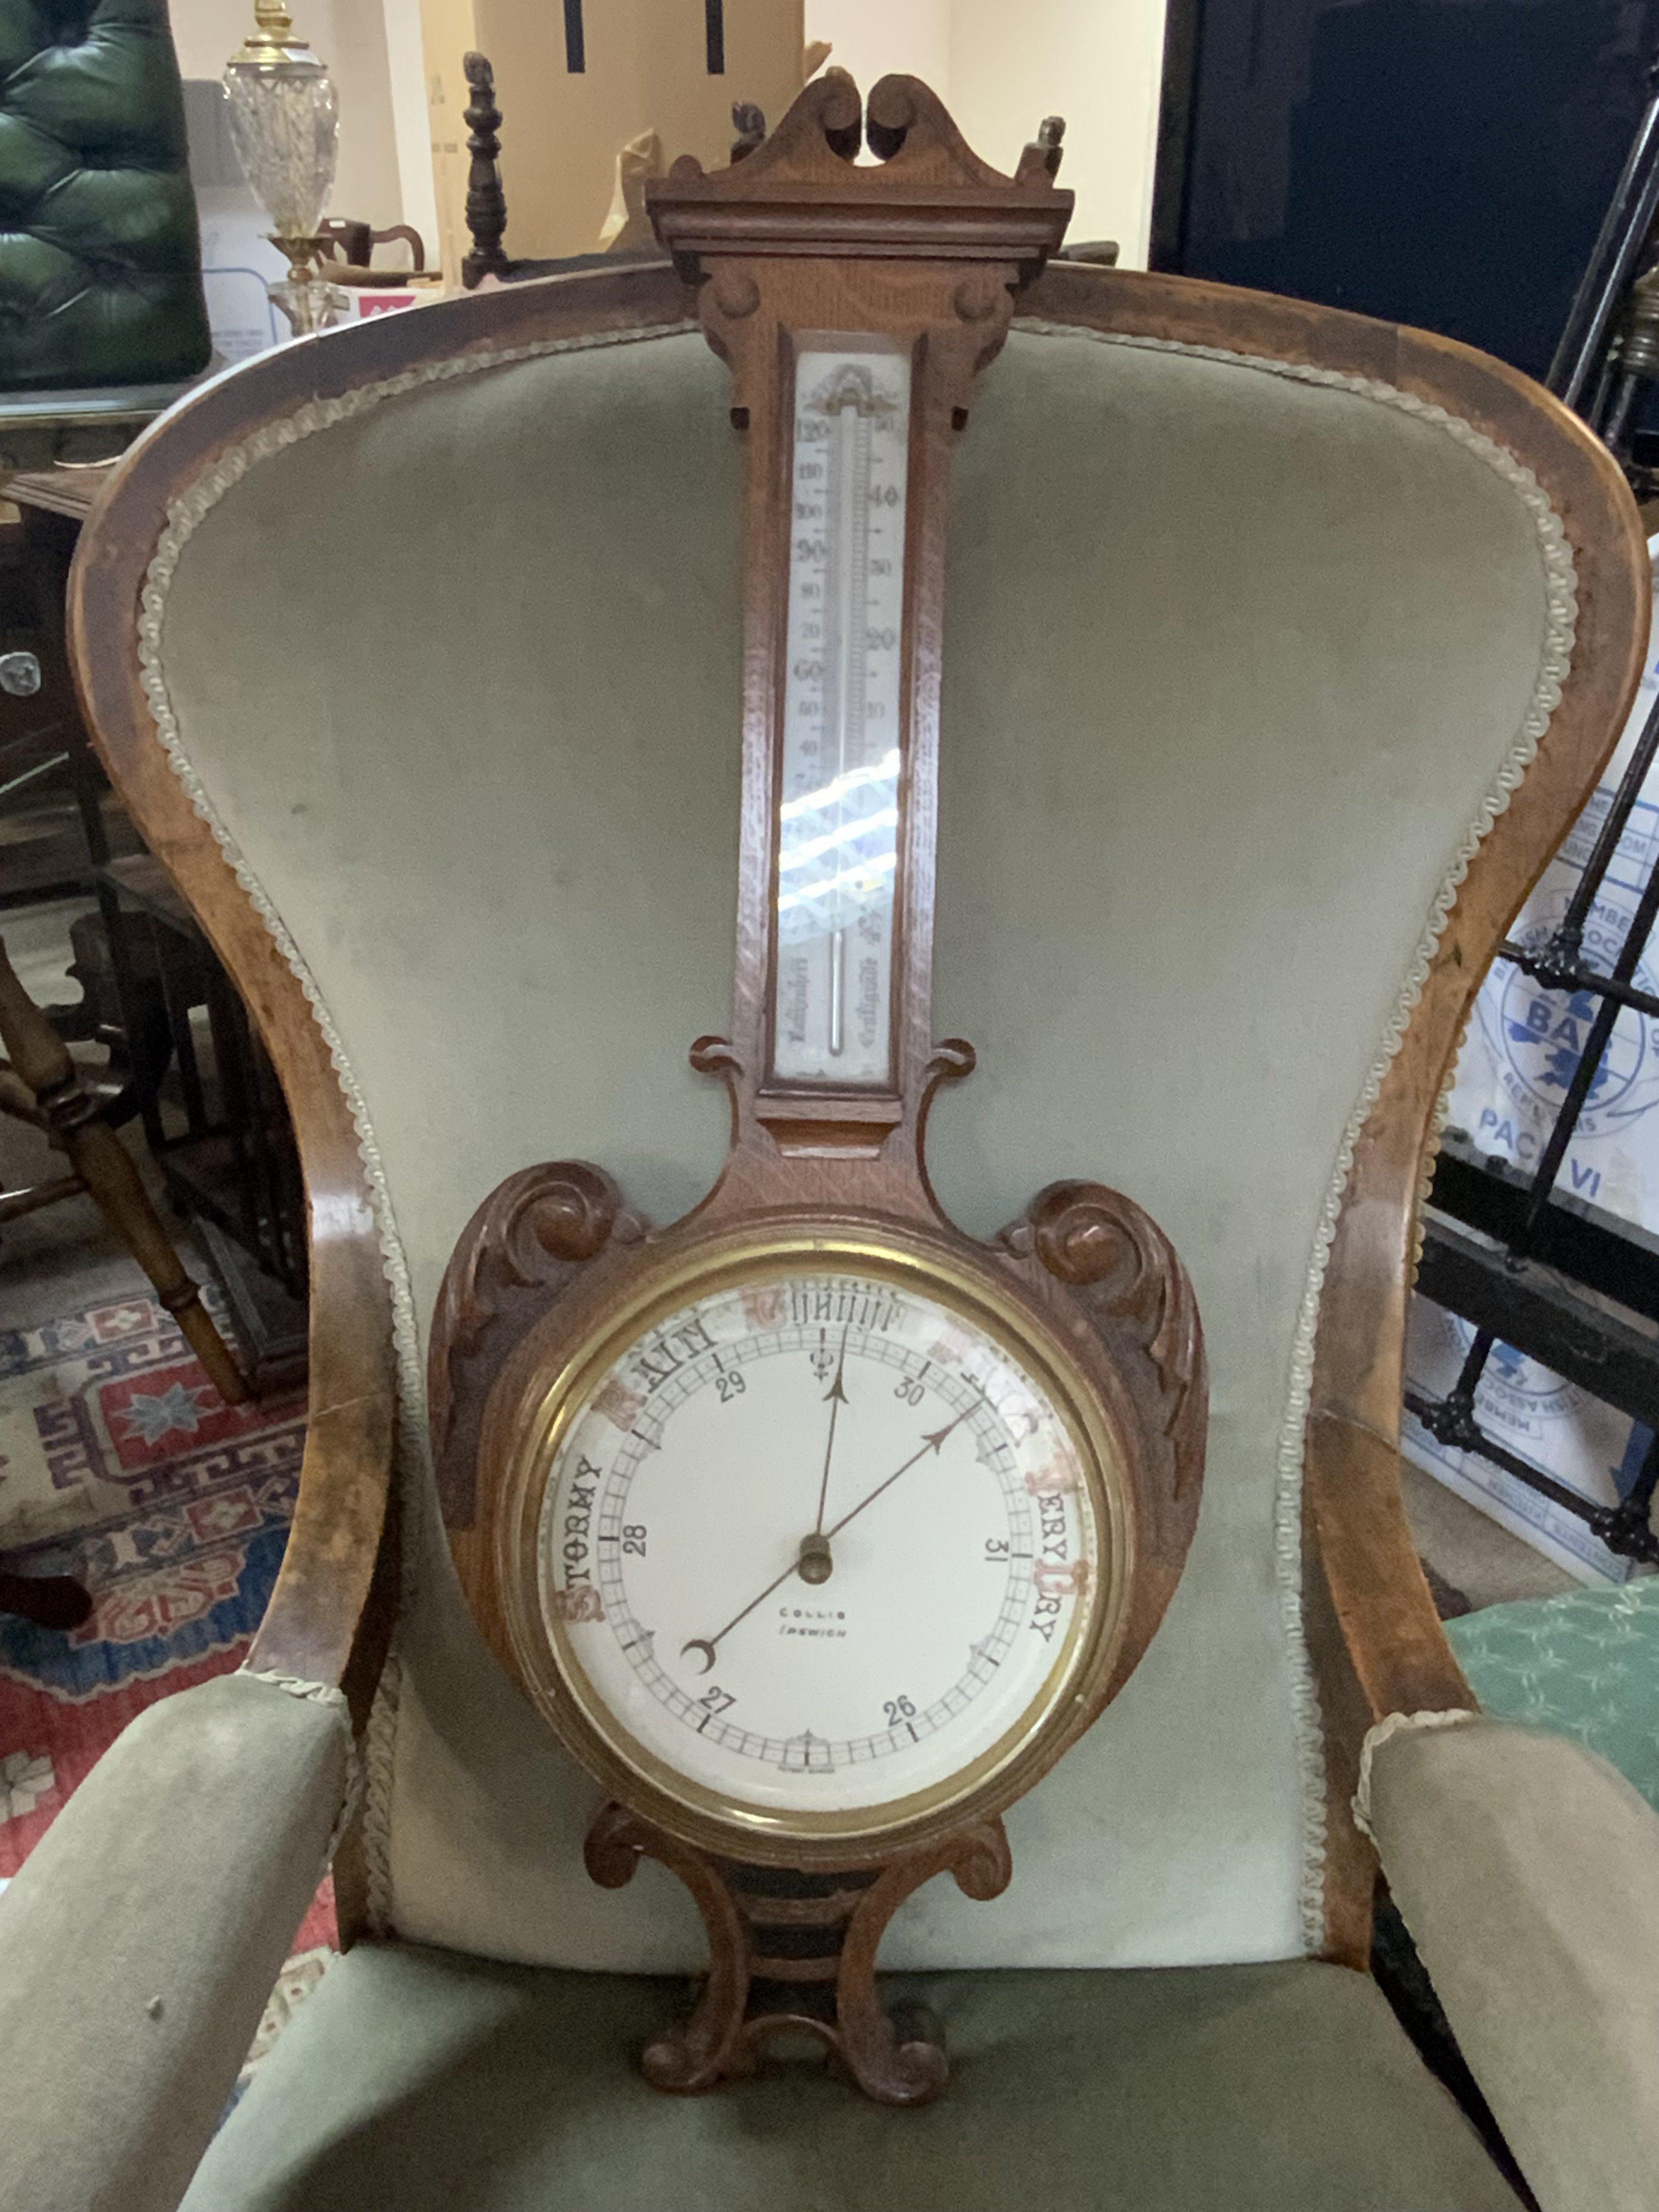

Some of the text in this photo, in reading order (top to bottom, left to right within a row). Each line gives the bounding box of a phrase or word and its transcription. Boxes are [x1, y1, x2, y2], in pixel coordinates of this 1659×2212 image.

[715, 1370, 746, 1403] 29
[893, 1374, 926, 1406] 30
[558, 1455, 606, 1625] STORMY
[622, 1525, 647, 1558] 28
[984, 1537, 1009, 1562] 31
[699, 1685, 737, 1714] 27
[883, 1694, 917, 1727] 26
